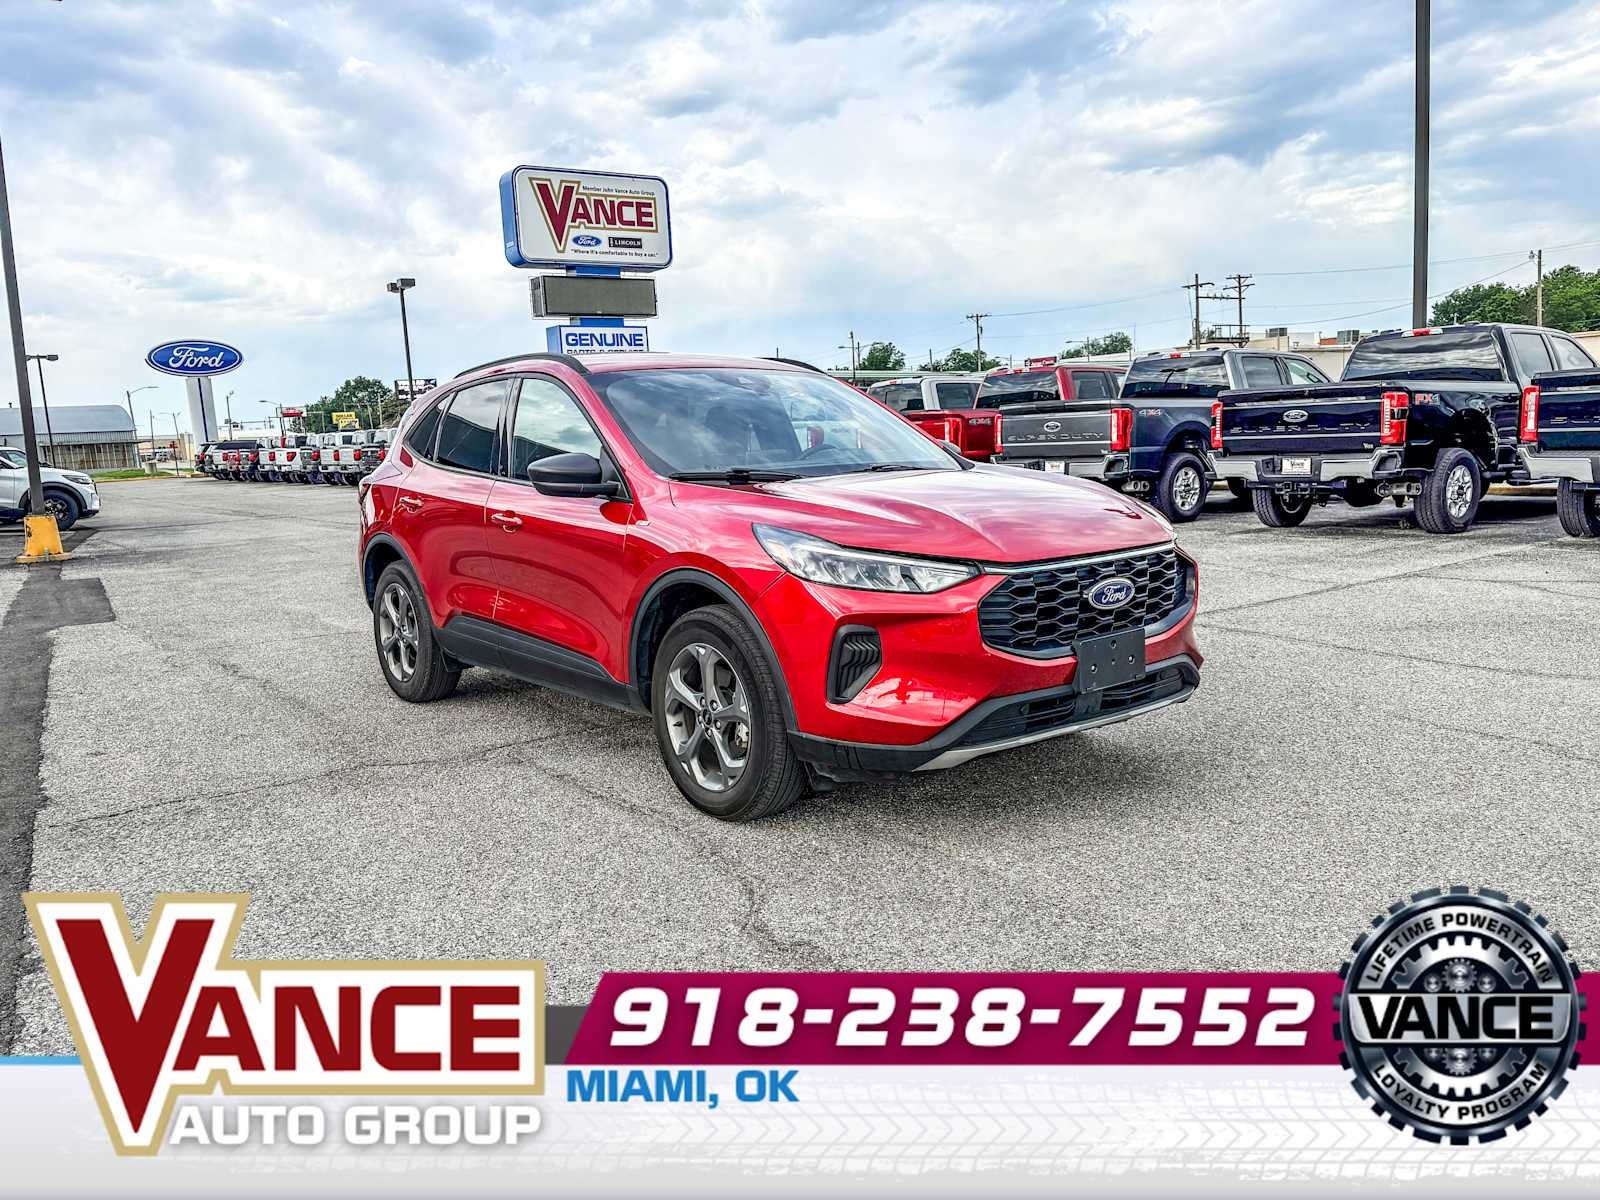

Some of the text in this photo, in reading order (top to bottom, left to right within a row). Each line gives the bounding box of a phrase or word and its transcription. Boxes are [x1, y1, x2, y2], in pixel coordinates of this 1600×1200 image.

[535, 183, 654, 250] VANCE
[565, 333, 644, 347] GENUINE
[168, 346, 224, 368] Ford
[1102, 585, 1128, 604] Ford
